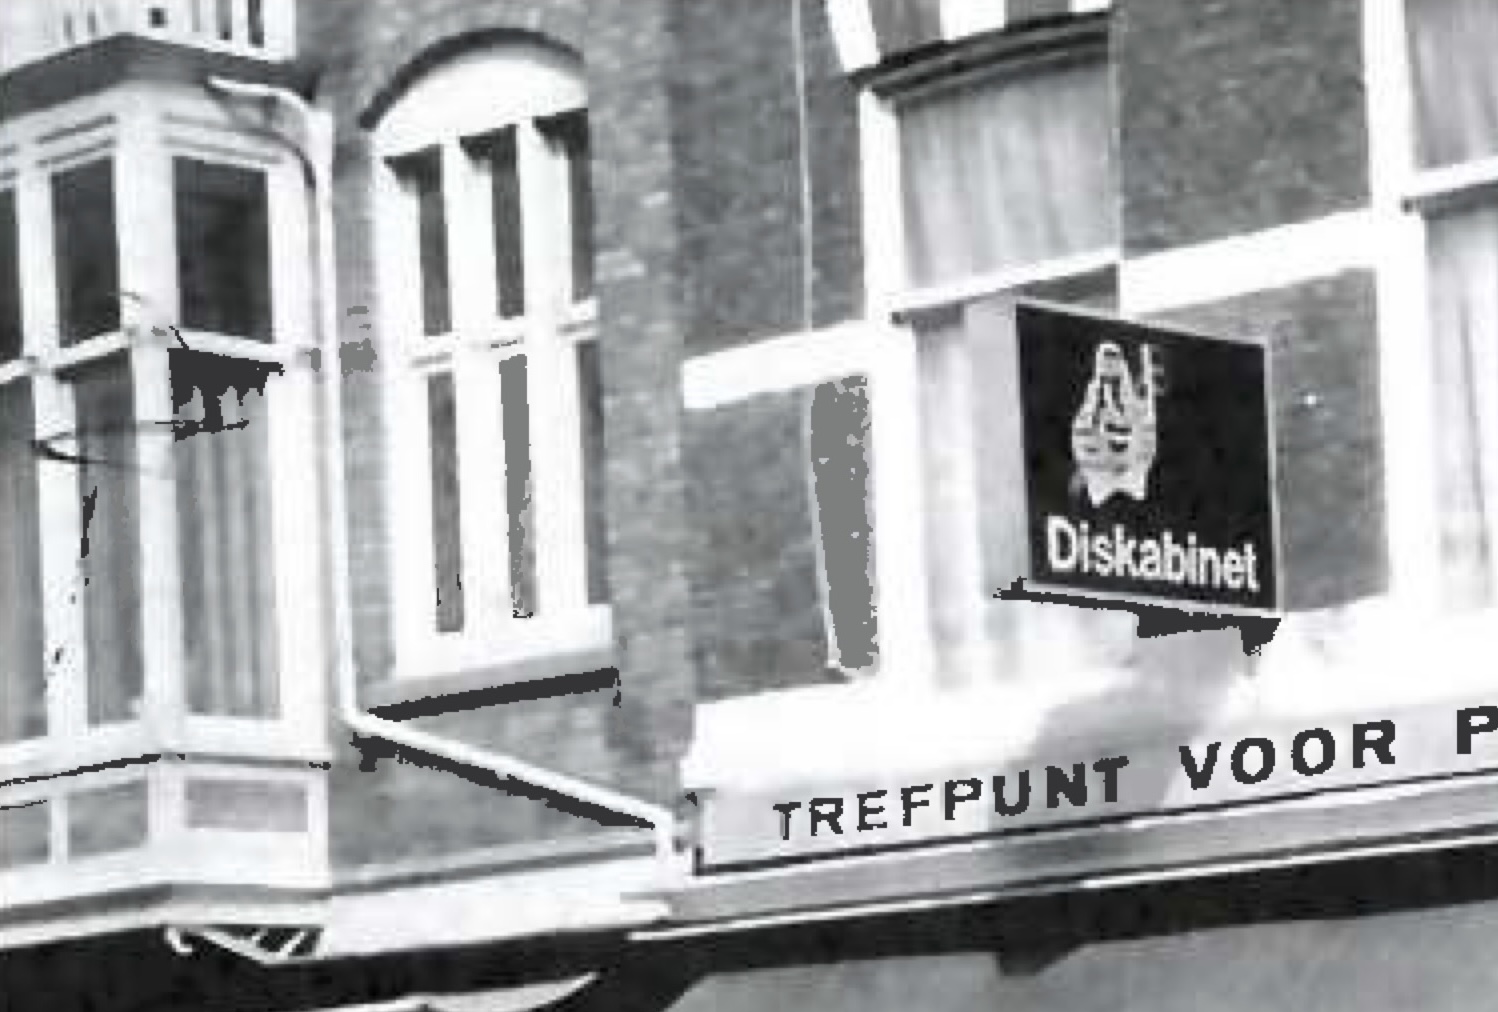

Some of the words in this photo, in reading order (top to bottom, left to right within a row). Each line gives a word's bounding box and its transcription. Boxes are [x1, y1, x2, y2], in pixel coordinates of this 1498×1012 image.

[1047, 515, 1261, 593] Diskabinet
[773, 755, 1130, 841] TREFPUNT
[1178, 719, 1396, 791] VOOR
